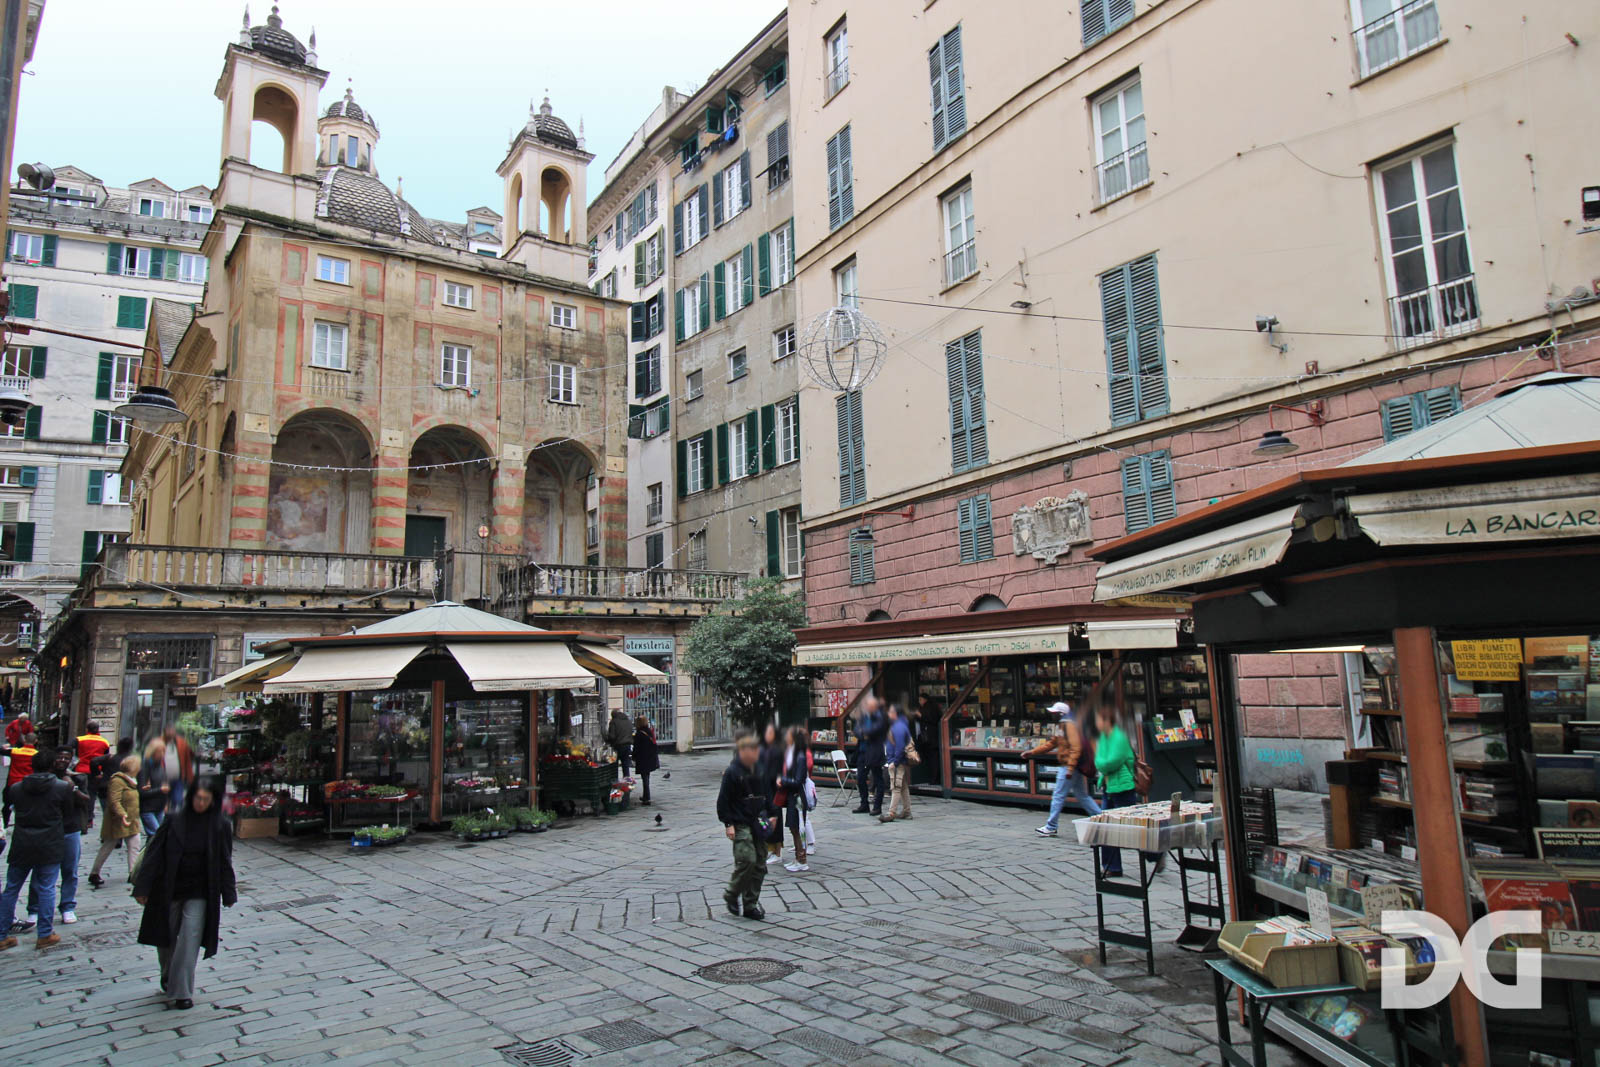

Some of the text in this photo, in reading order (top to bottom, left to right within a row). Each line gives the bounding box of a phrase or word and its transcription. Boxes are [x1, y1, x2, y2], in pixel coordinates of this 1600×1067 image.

[1445, 510, 1600, 536] LA BANCAR
[1162, 568, 1177, 583] LIBRI
[1182, 559, 1209, 578] FUMETTI
[1214, 552, 1240, 570] DISCHI
[1248, 547, 1266, 562] FILM
[974, 643, 1001, 653] FUMETTI
[1011, 641, 1031, 651] DISCHI
[1041, 639, 1057, 649] FILM
[1456, 644, 1517, 652] LIBRI FUMETTI
[1542, 832, 1576, 840] GRANDI
[1551, 931, 1570, 946] LP
